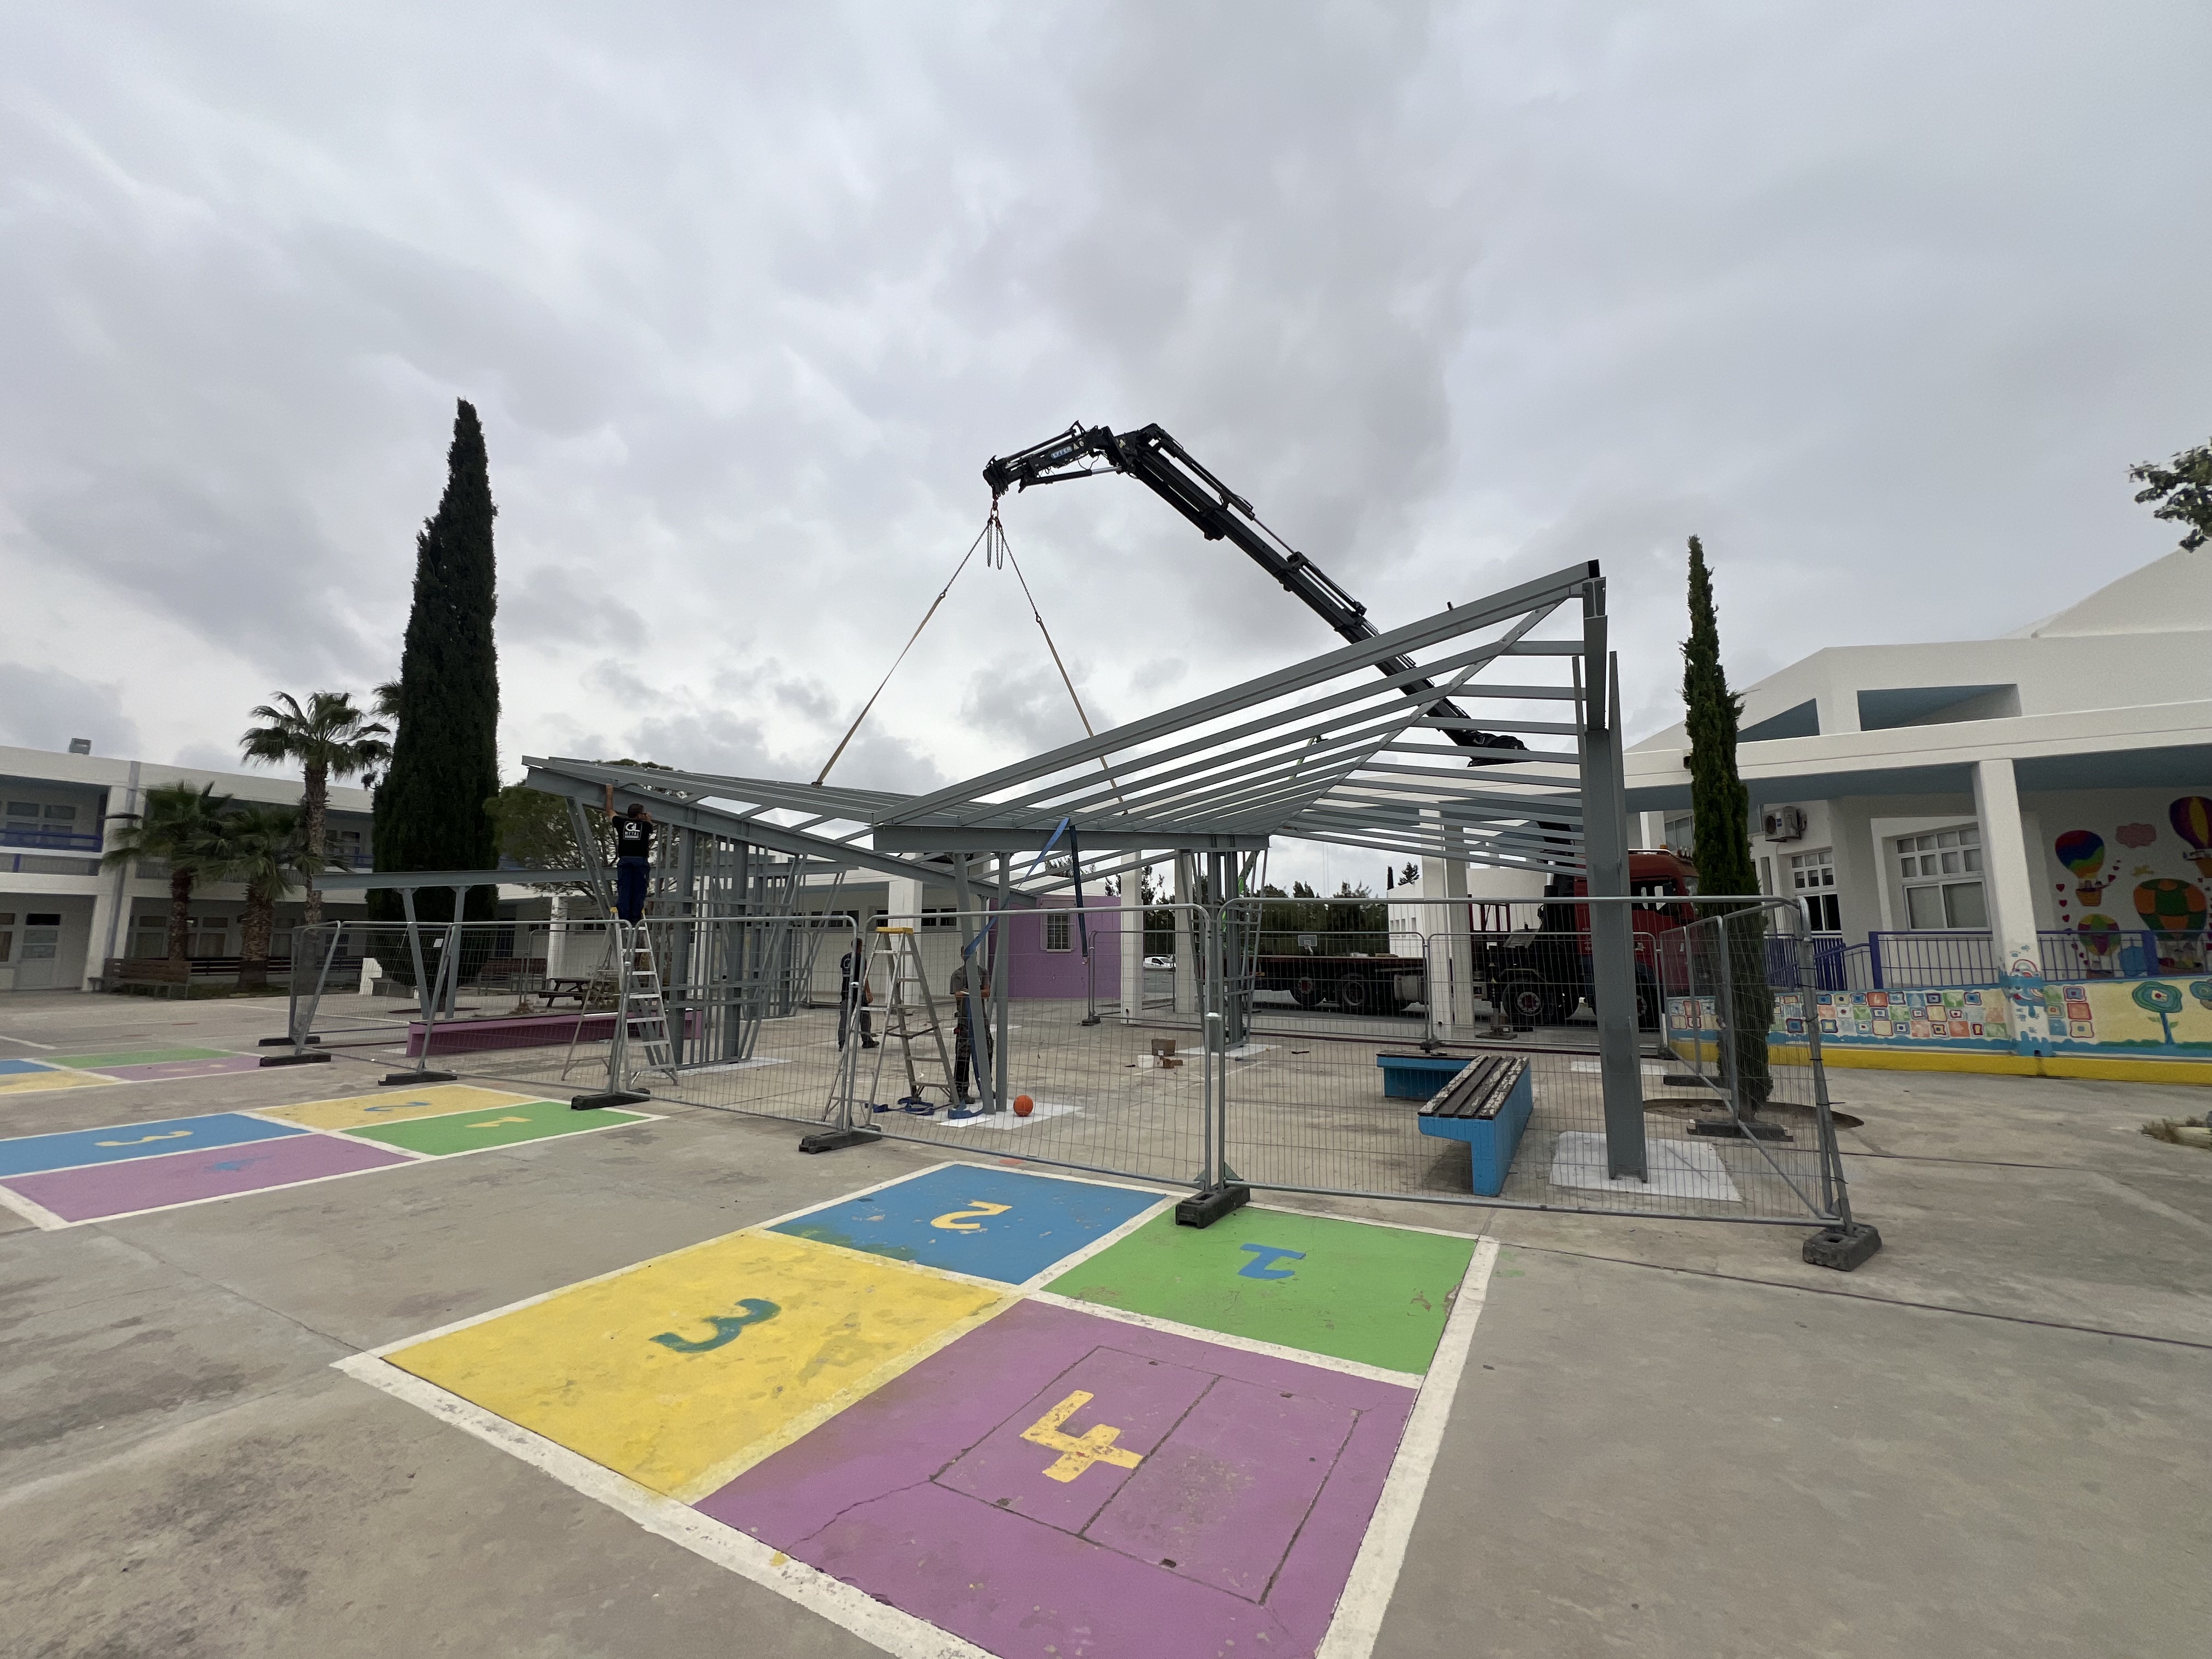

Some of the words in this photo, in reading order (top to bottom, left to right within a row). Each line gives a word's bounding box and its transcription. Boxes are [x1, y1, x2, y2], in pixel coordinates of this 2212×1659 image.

[930, 1200, 1012, 1229] 2
[1239, 1243, 1306, 1280] 1
[647, 1297, 782, 1353] 3
[1019, 1390, 1144, 1483] 4
